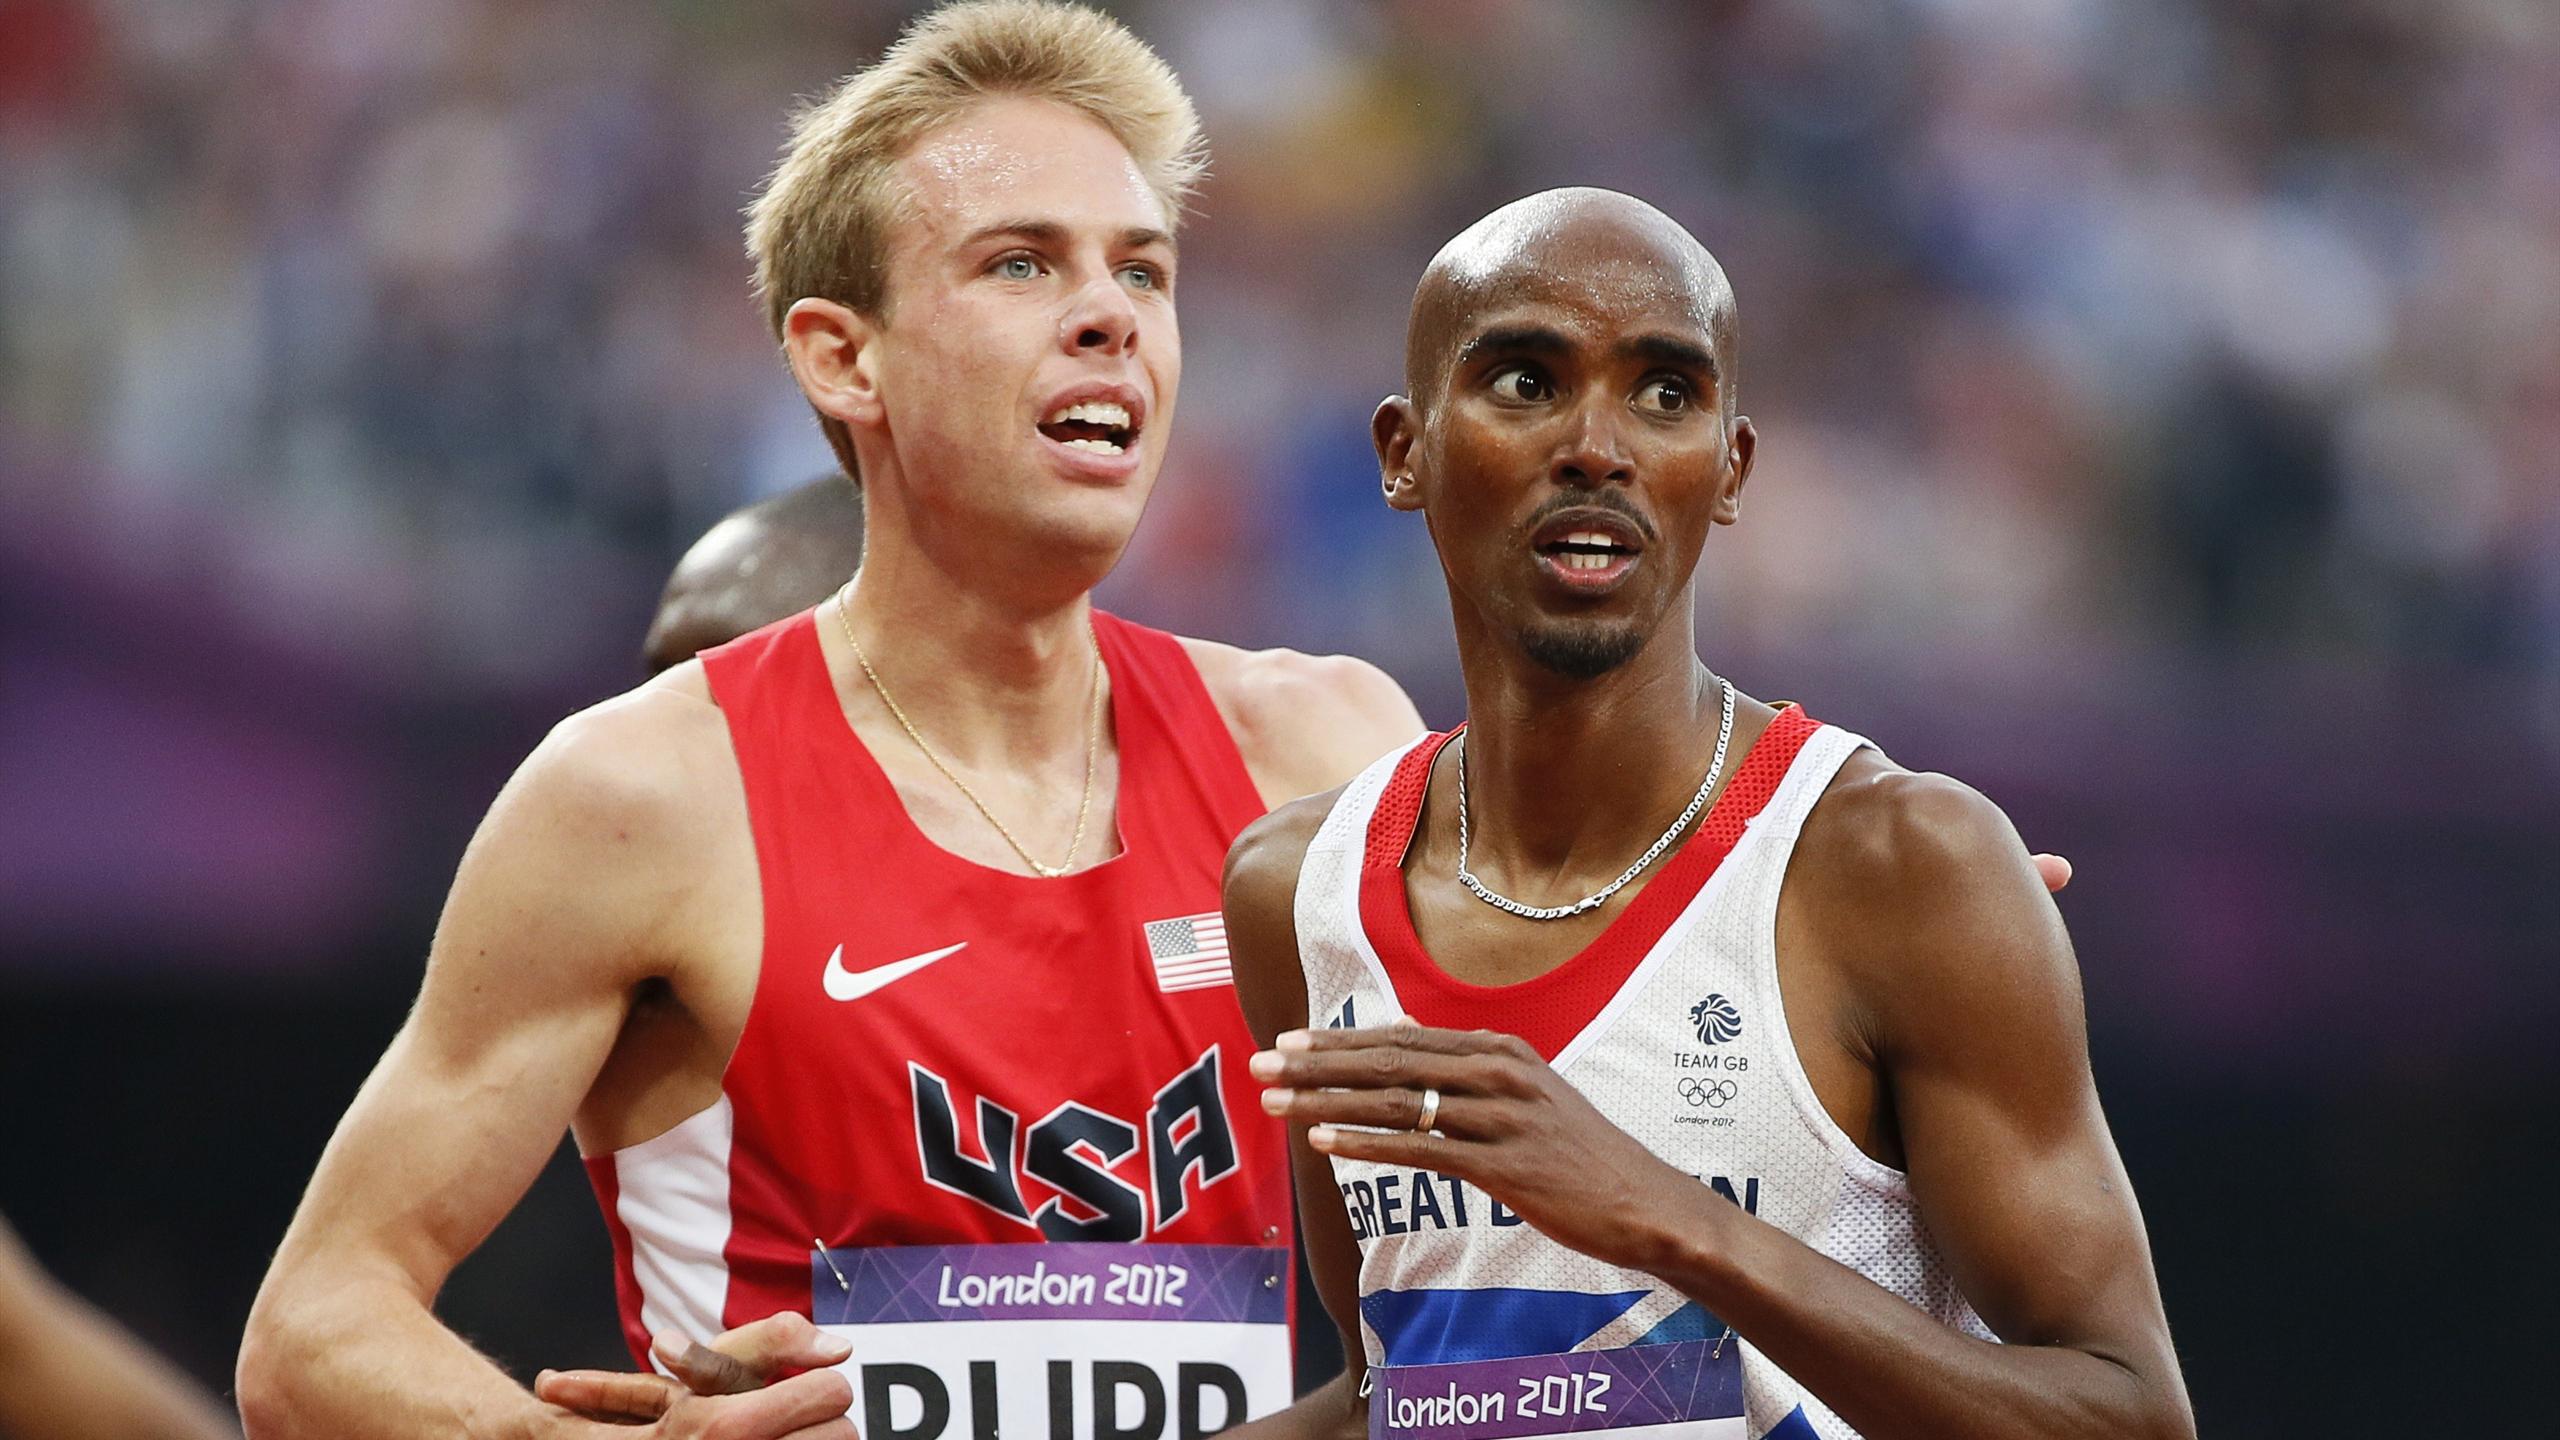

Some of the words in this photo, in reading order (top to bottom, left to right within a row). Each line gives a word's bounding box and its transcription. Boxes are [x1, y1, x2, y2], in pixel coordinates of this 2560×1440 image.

[1674, 1053, 1718, 1069] TEAM
[1724, 1056, 1748, 1071] GB
[907, 1043, 1239, 1244] USA
[1674, 1114, 1709, 1126] London
[1712, 1117, 1734, 1127] 2012
[1341, 1172, 1468, 1241] GREAT
[938, 1261, 1096, 1308] London
[1104, 1263, 1188, 1307] 2012
[1387, 1382, 1505, 1429] London
[1516, 1371, 1611, 1418] 2012
